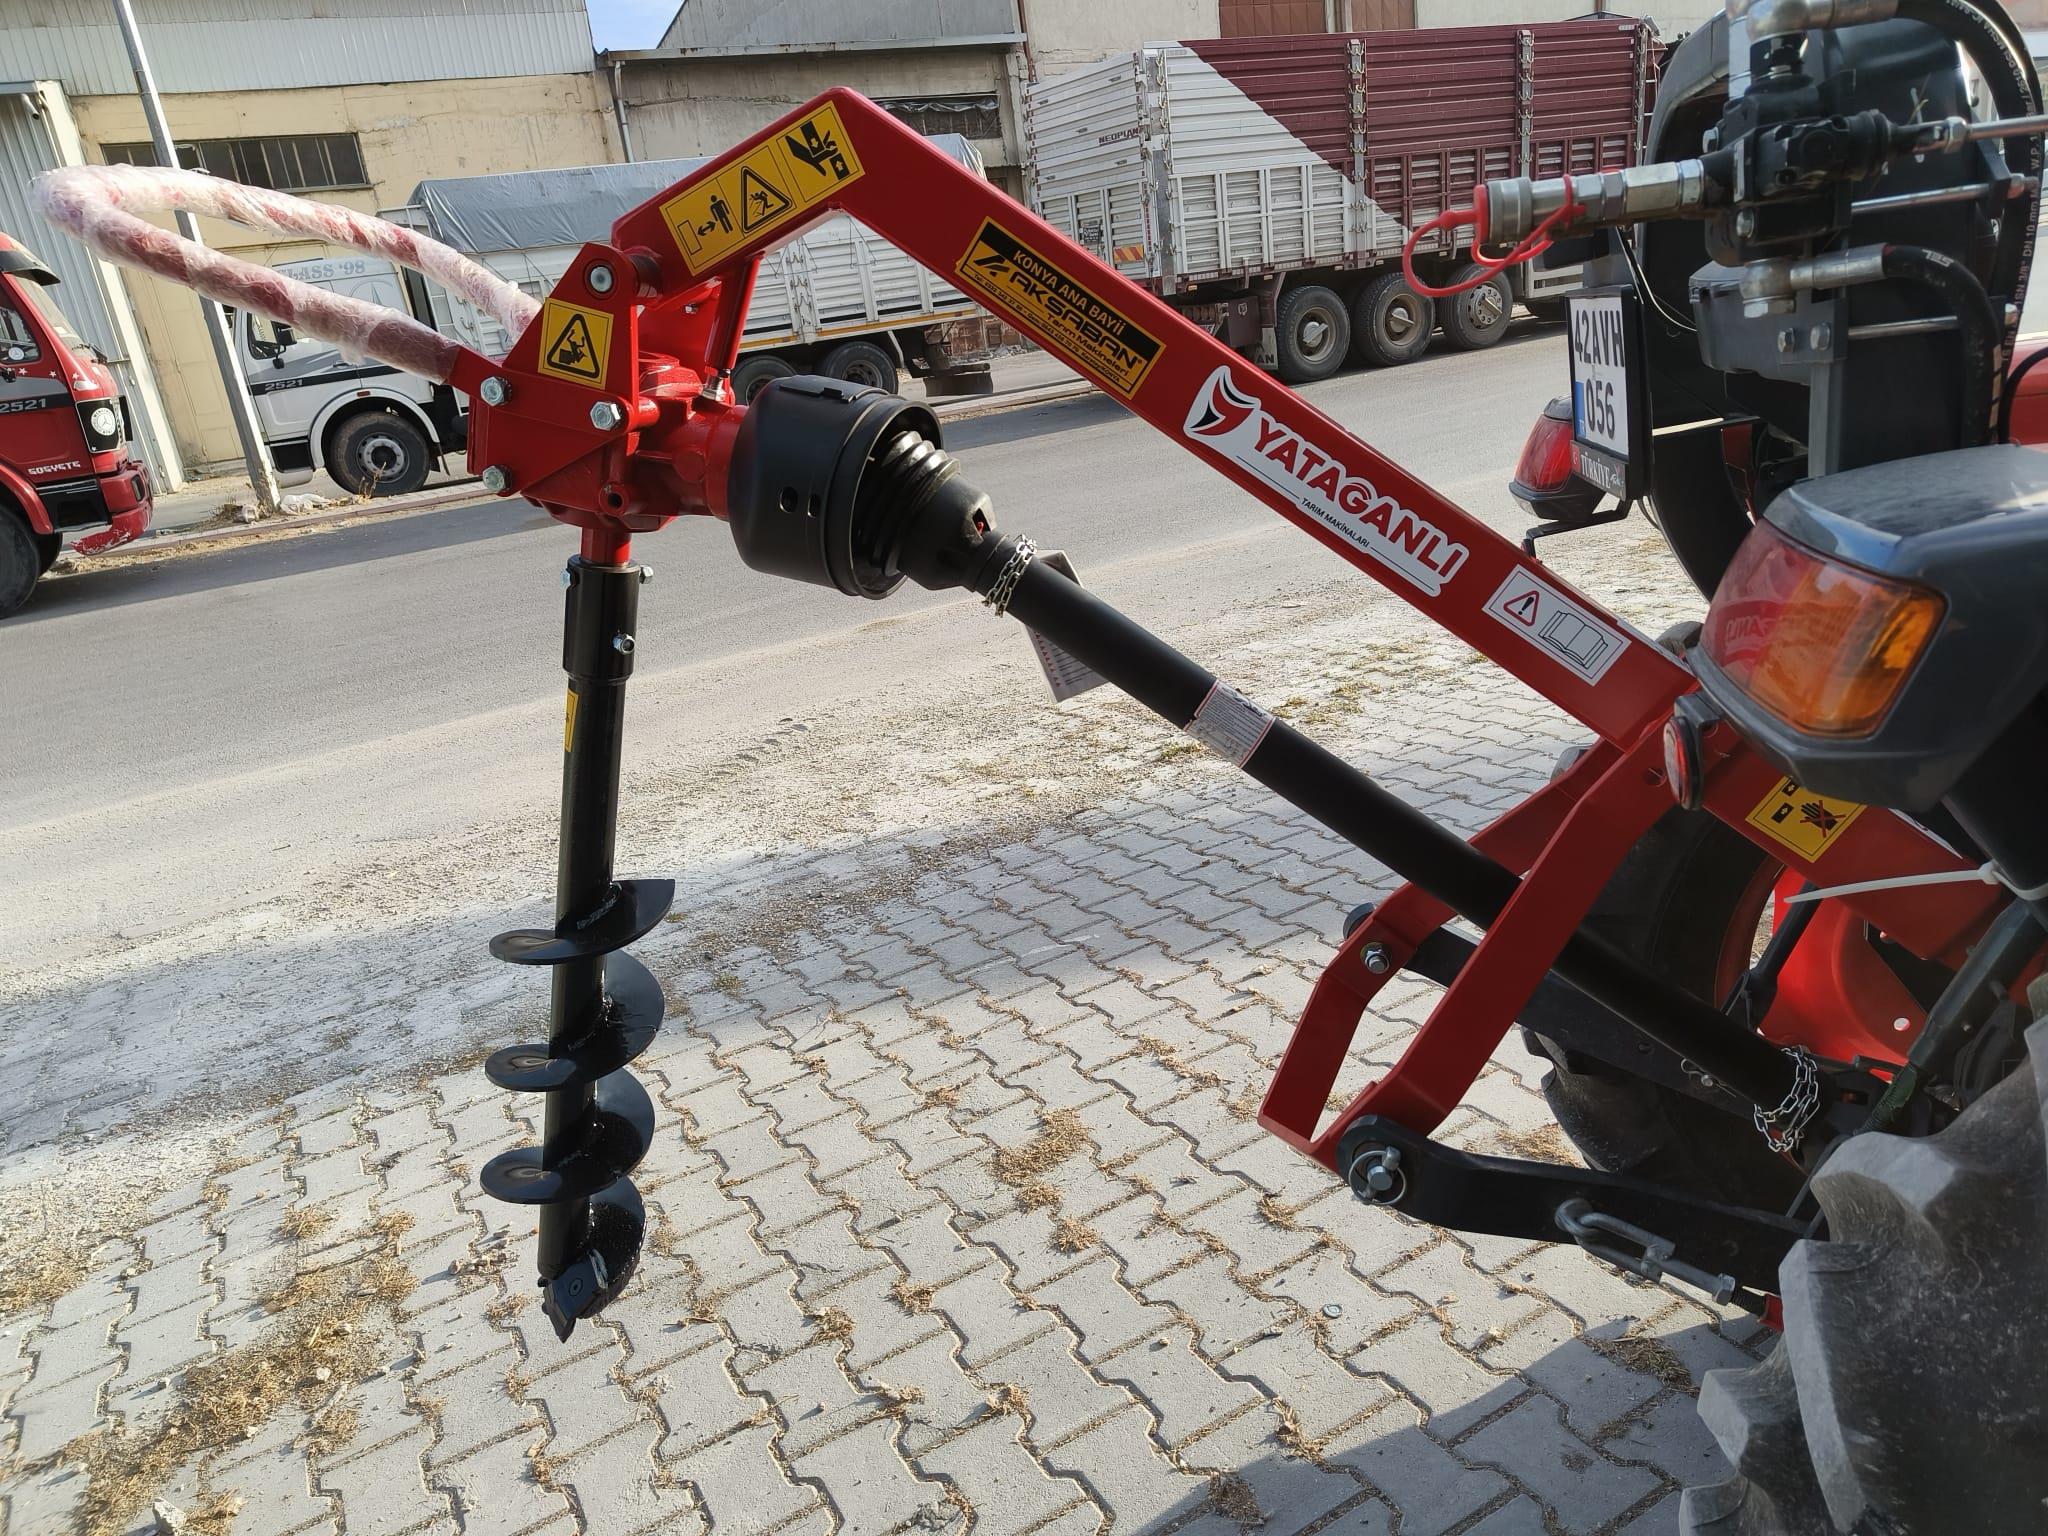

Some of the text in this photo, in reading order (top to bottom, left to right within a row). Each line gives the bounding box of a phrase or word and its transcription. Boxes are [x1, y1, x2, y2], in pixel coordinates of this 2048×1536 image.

[2003, 48, 2017, 68] PSI
[2030, 202, 2040, 222] mm
[2026, 224, 2036, 238] 10
[2023, 238, 2033, 257] DN
[278, 264, 335, 280] LASS
[1013, 250, 1059, 289] KONYA
[1058, 284, 1087, 311] ANA
[1009, 272, 1137, 369] AKSABAN
[1076, 333, 1129, 377] Makineleri
[1254, 353, 1276, 364] AN
[265, 379, 304, 391] 2521
[0, 398, 47, 412] 2521
[1585, 379, 1616, 440] 056
[1581, 451, 1611, 489] TÜRKİYE
[1300, 497, 1370, 548] TARIM MAKİNALARI
